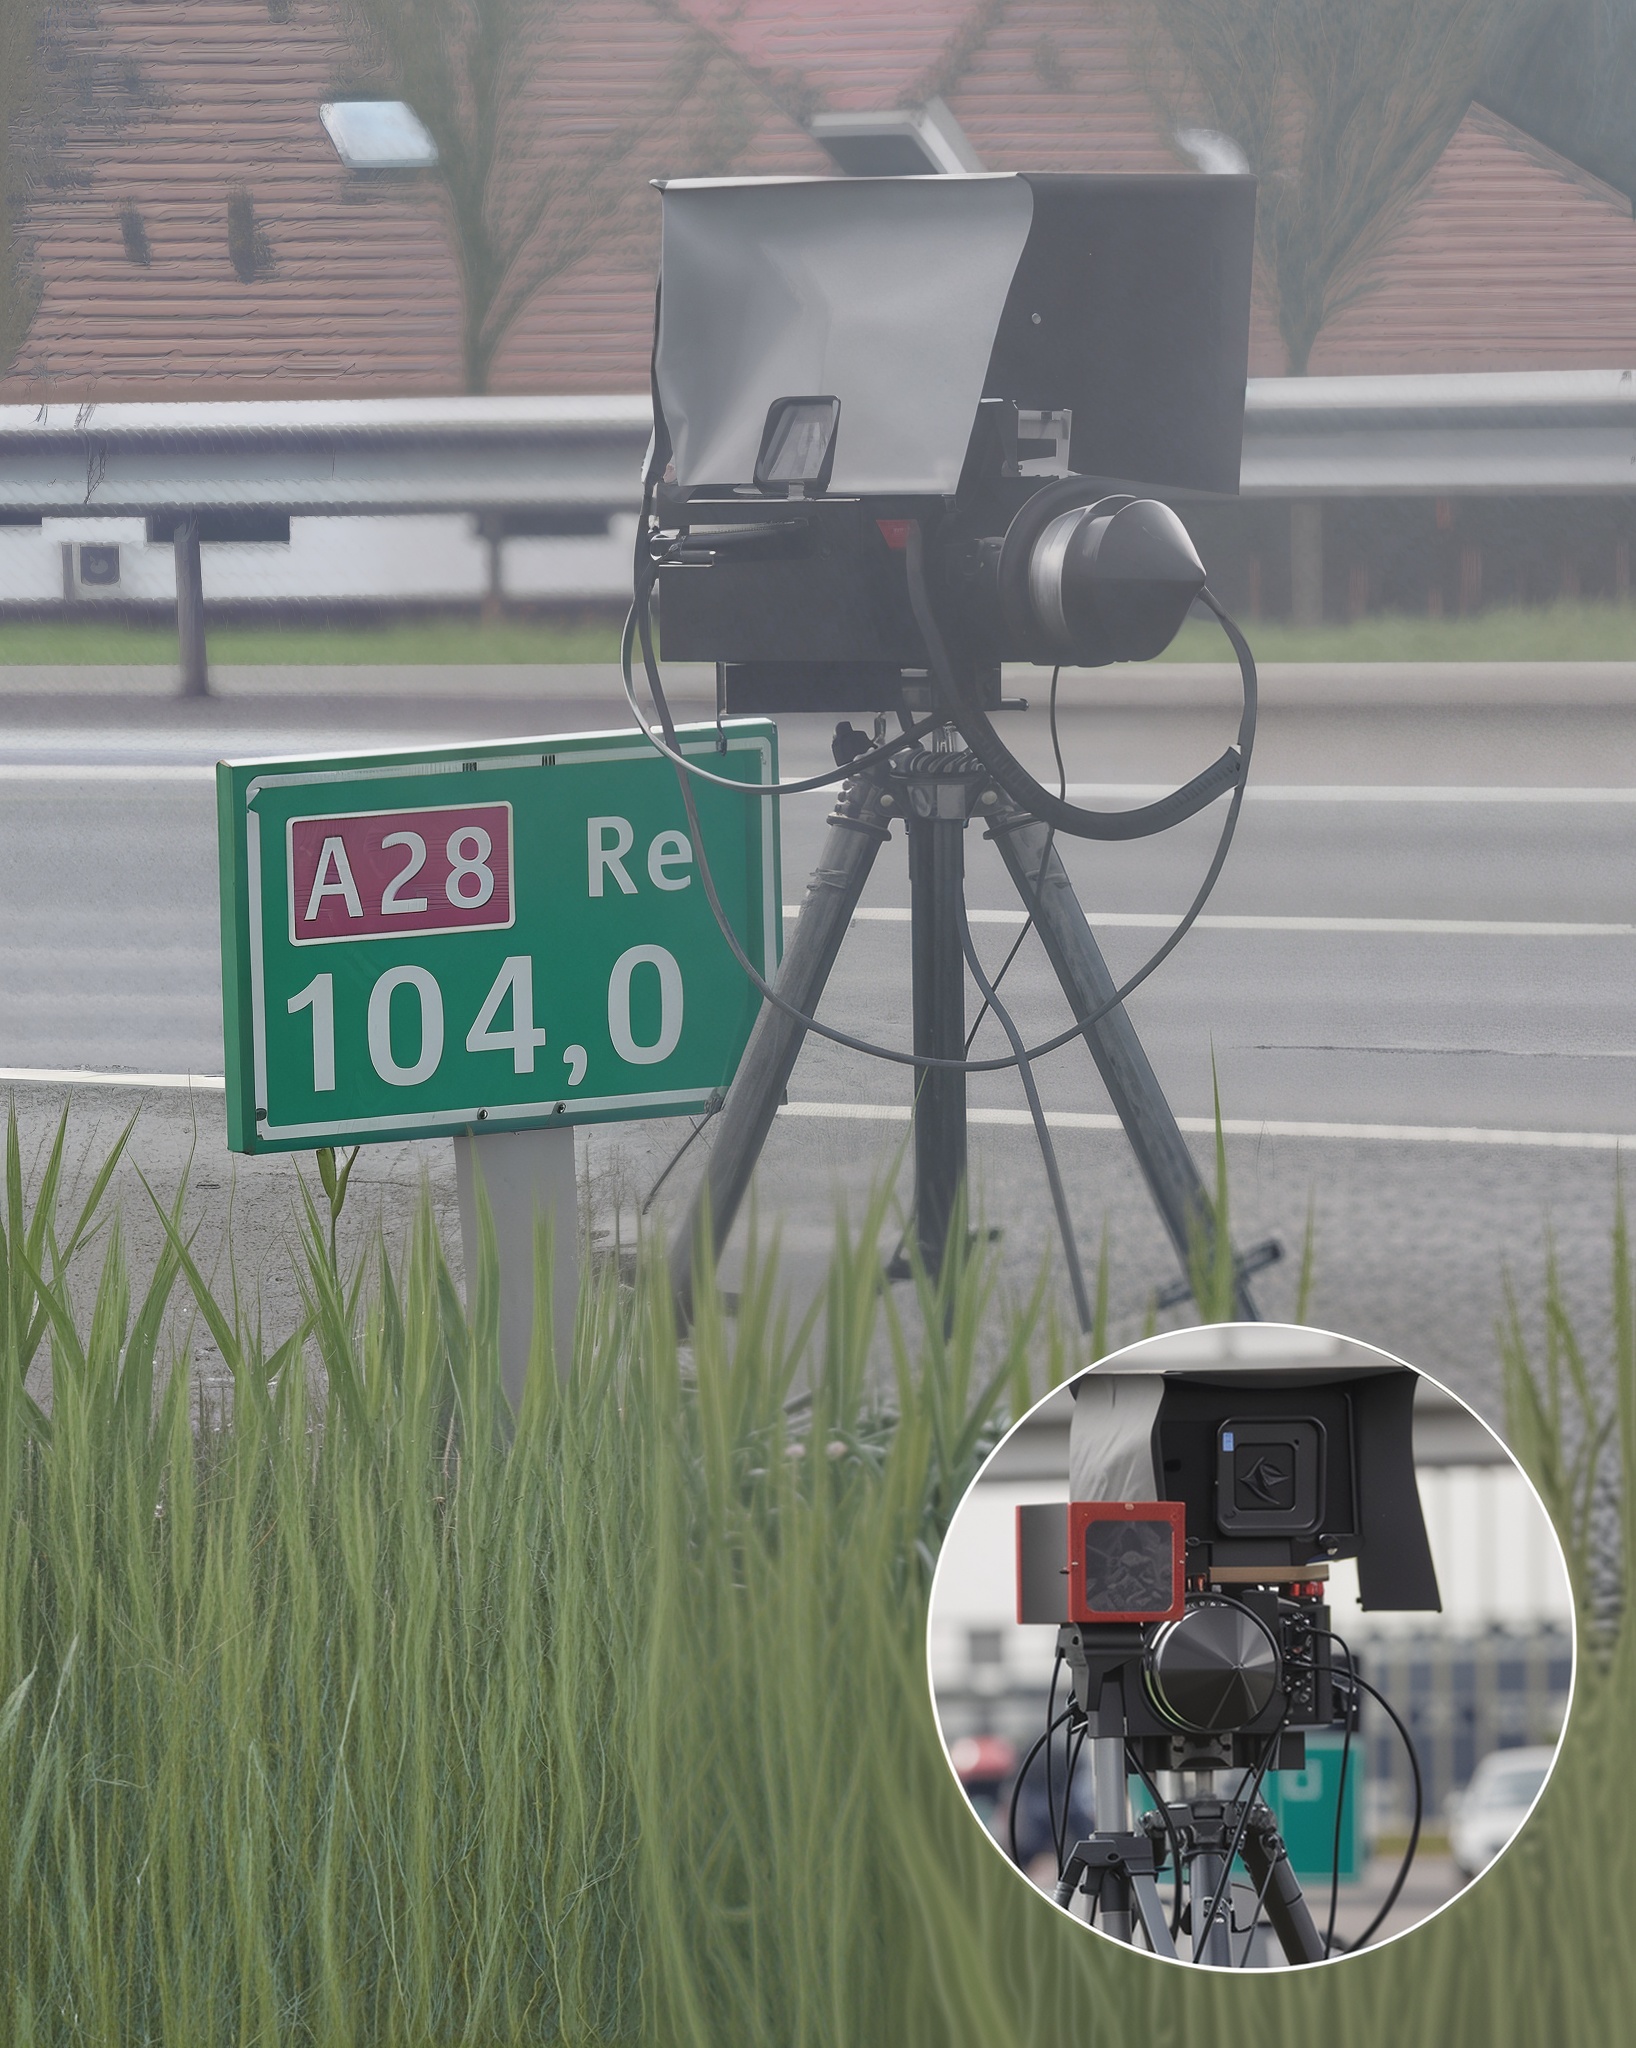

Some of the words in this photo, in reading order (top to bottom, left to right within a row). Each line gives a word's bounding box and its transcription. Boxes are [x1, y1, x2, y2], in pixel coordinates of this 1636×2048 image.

[303, 826, 495, 921] A28
[587, 815, 693, 898] Re
[287, 944, 684, 1092] 104,0
